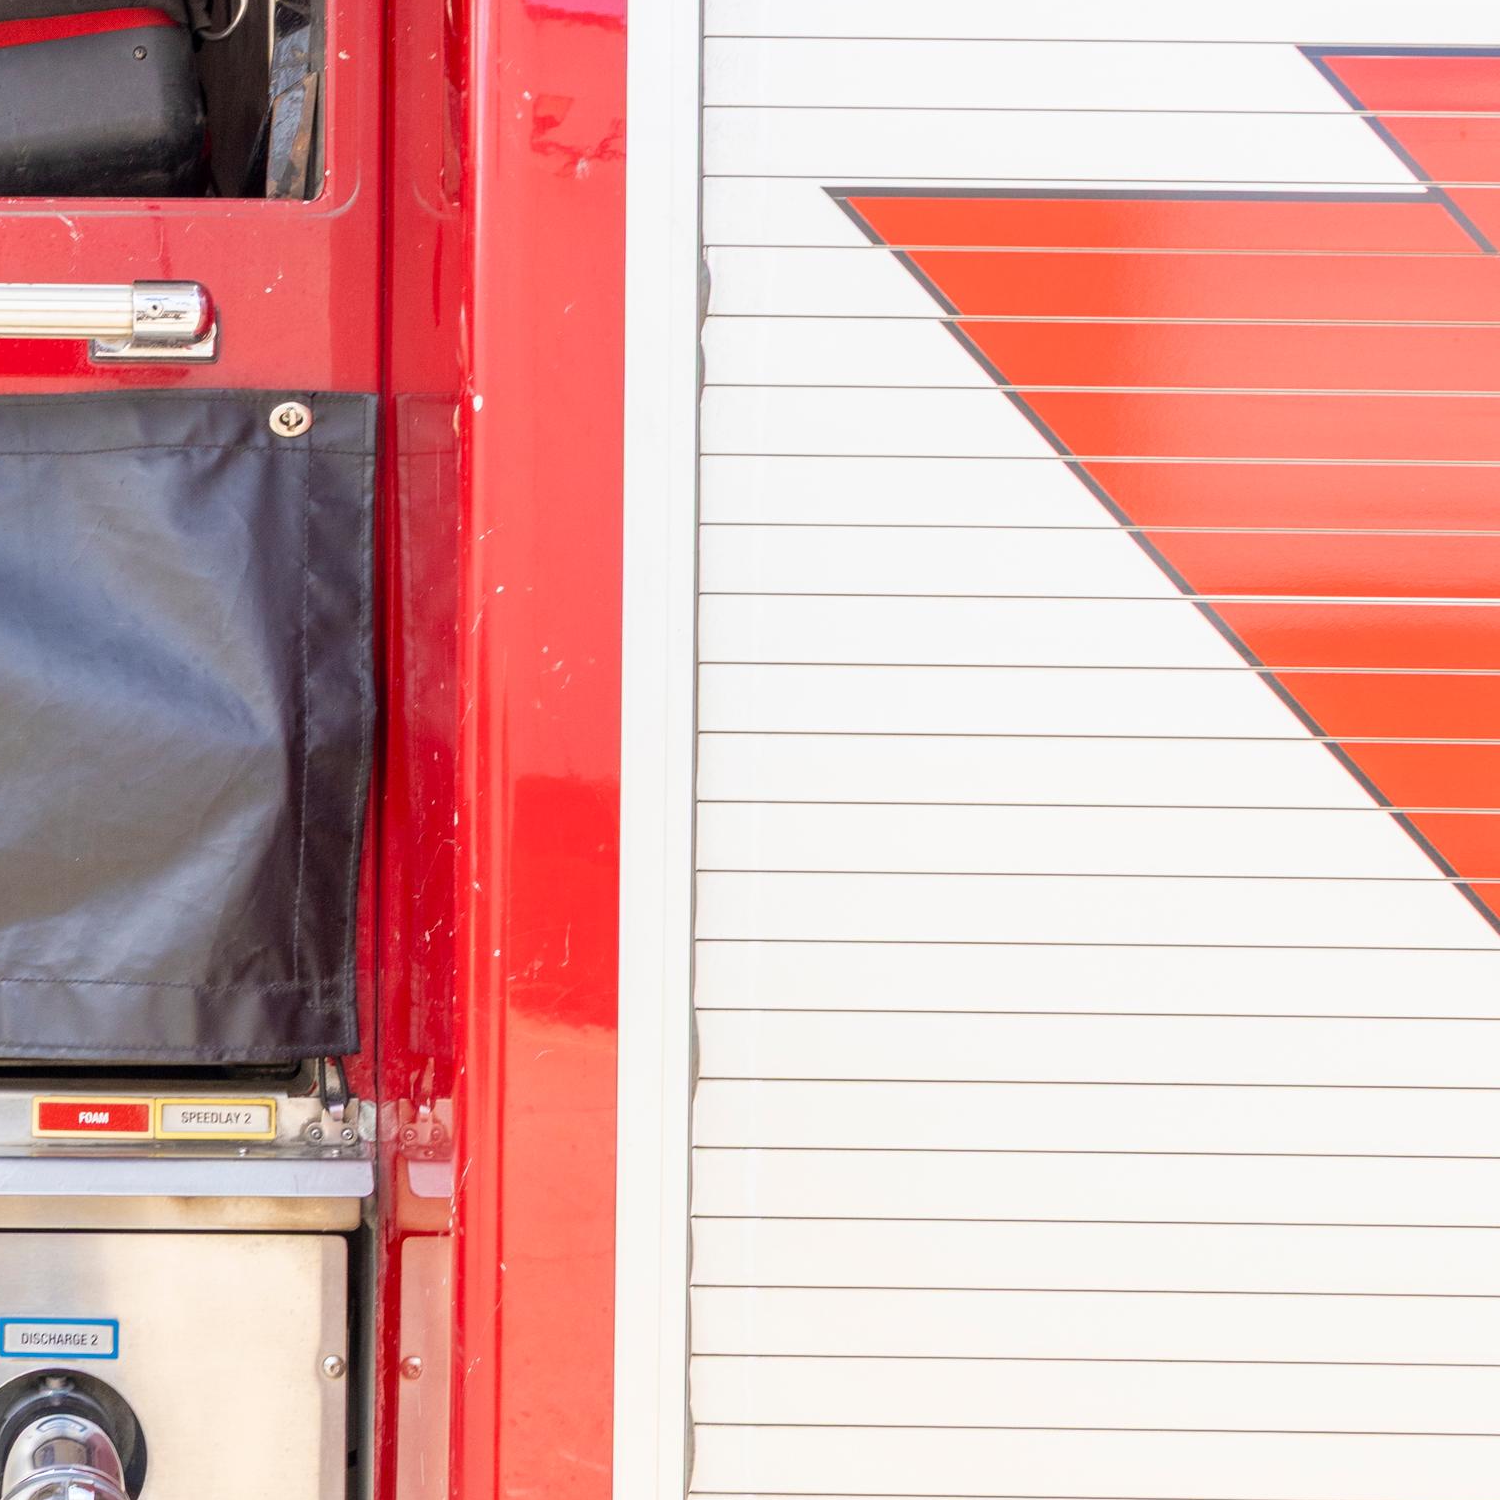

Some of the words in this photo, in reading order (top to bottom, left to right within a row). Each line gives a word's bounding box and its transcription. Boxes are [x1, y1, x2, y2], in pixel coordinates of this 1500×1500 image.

[78, 1111, 109, 1124] FOAM
[181, 1111, 240, 1124] SPEEDLAY
[244, 1112, 251, 1124] 2
[21, 1333, 88, 1346] DISCHARGE
[90, 1333, 99, 1346] 2
